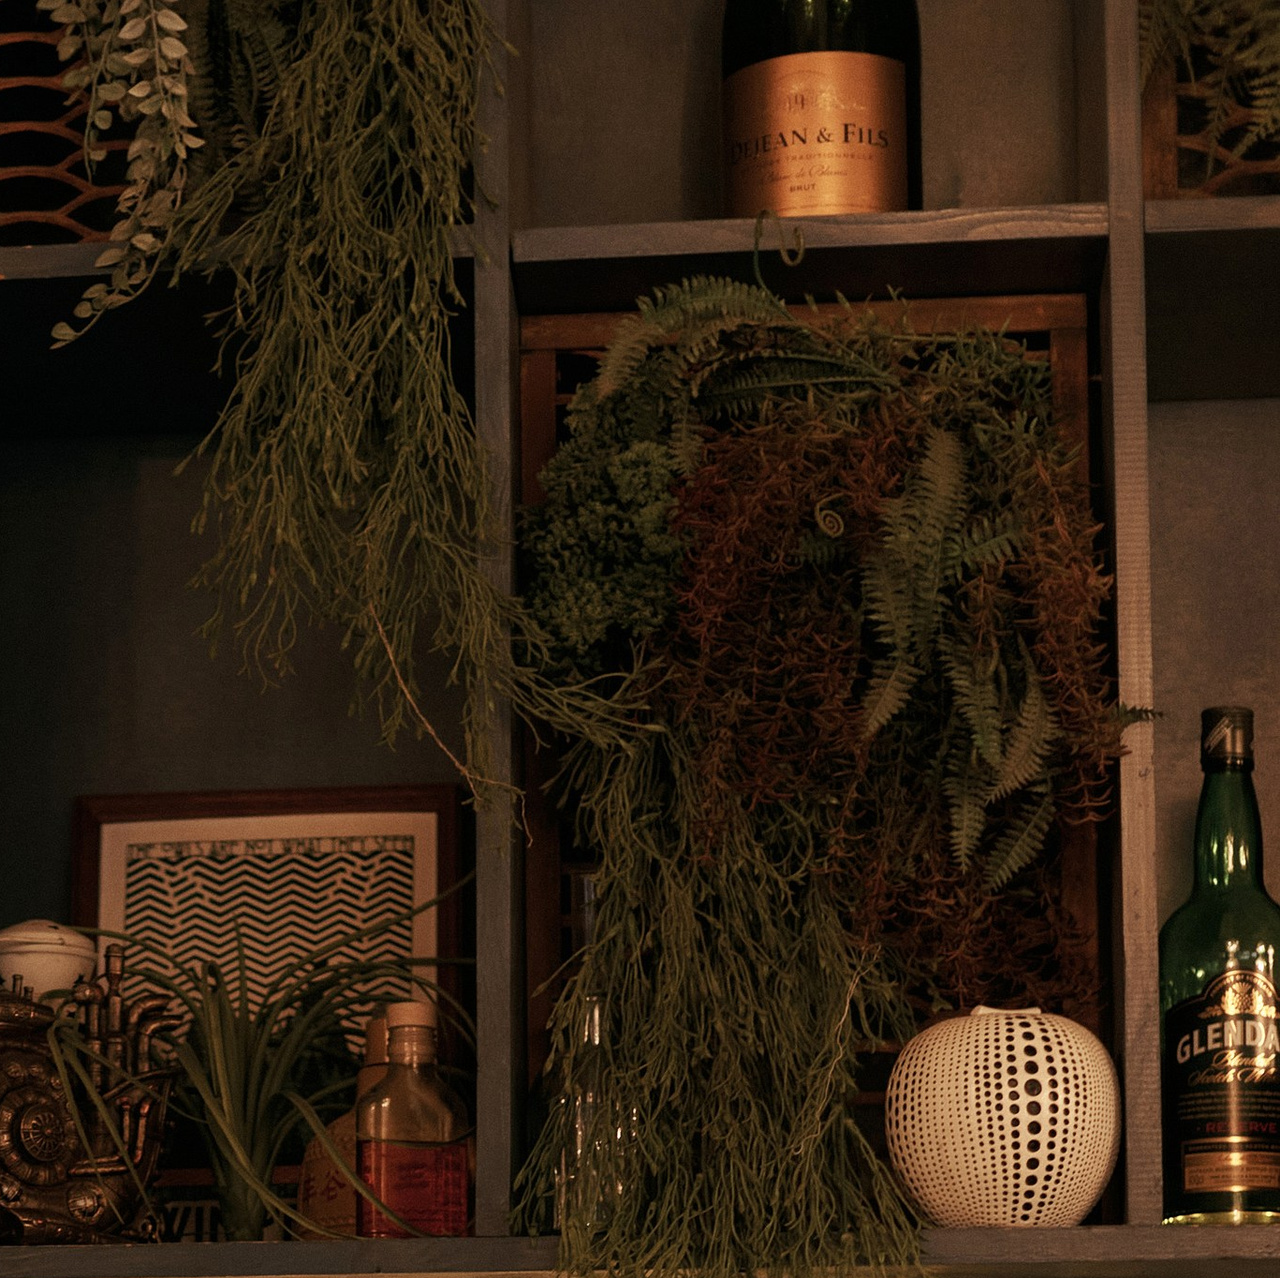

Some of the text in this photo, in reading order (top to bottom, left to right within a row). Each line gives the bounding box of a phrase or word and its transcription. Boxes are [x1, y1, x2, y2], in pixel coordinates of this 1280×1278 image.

[816, 128, 831, 144] &
[843, 123, 888, 148] FILS
[790, 183, 816, 192] BRUT
[245, 839, 273, 856] NOT
